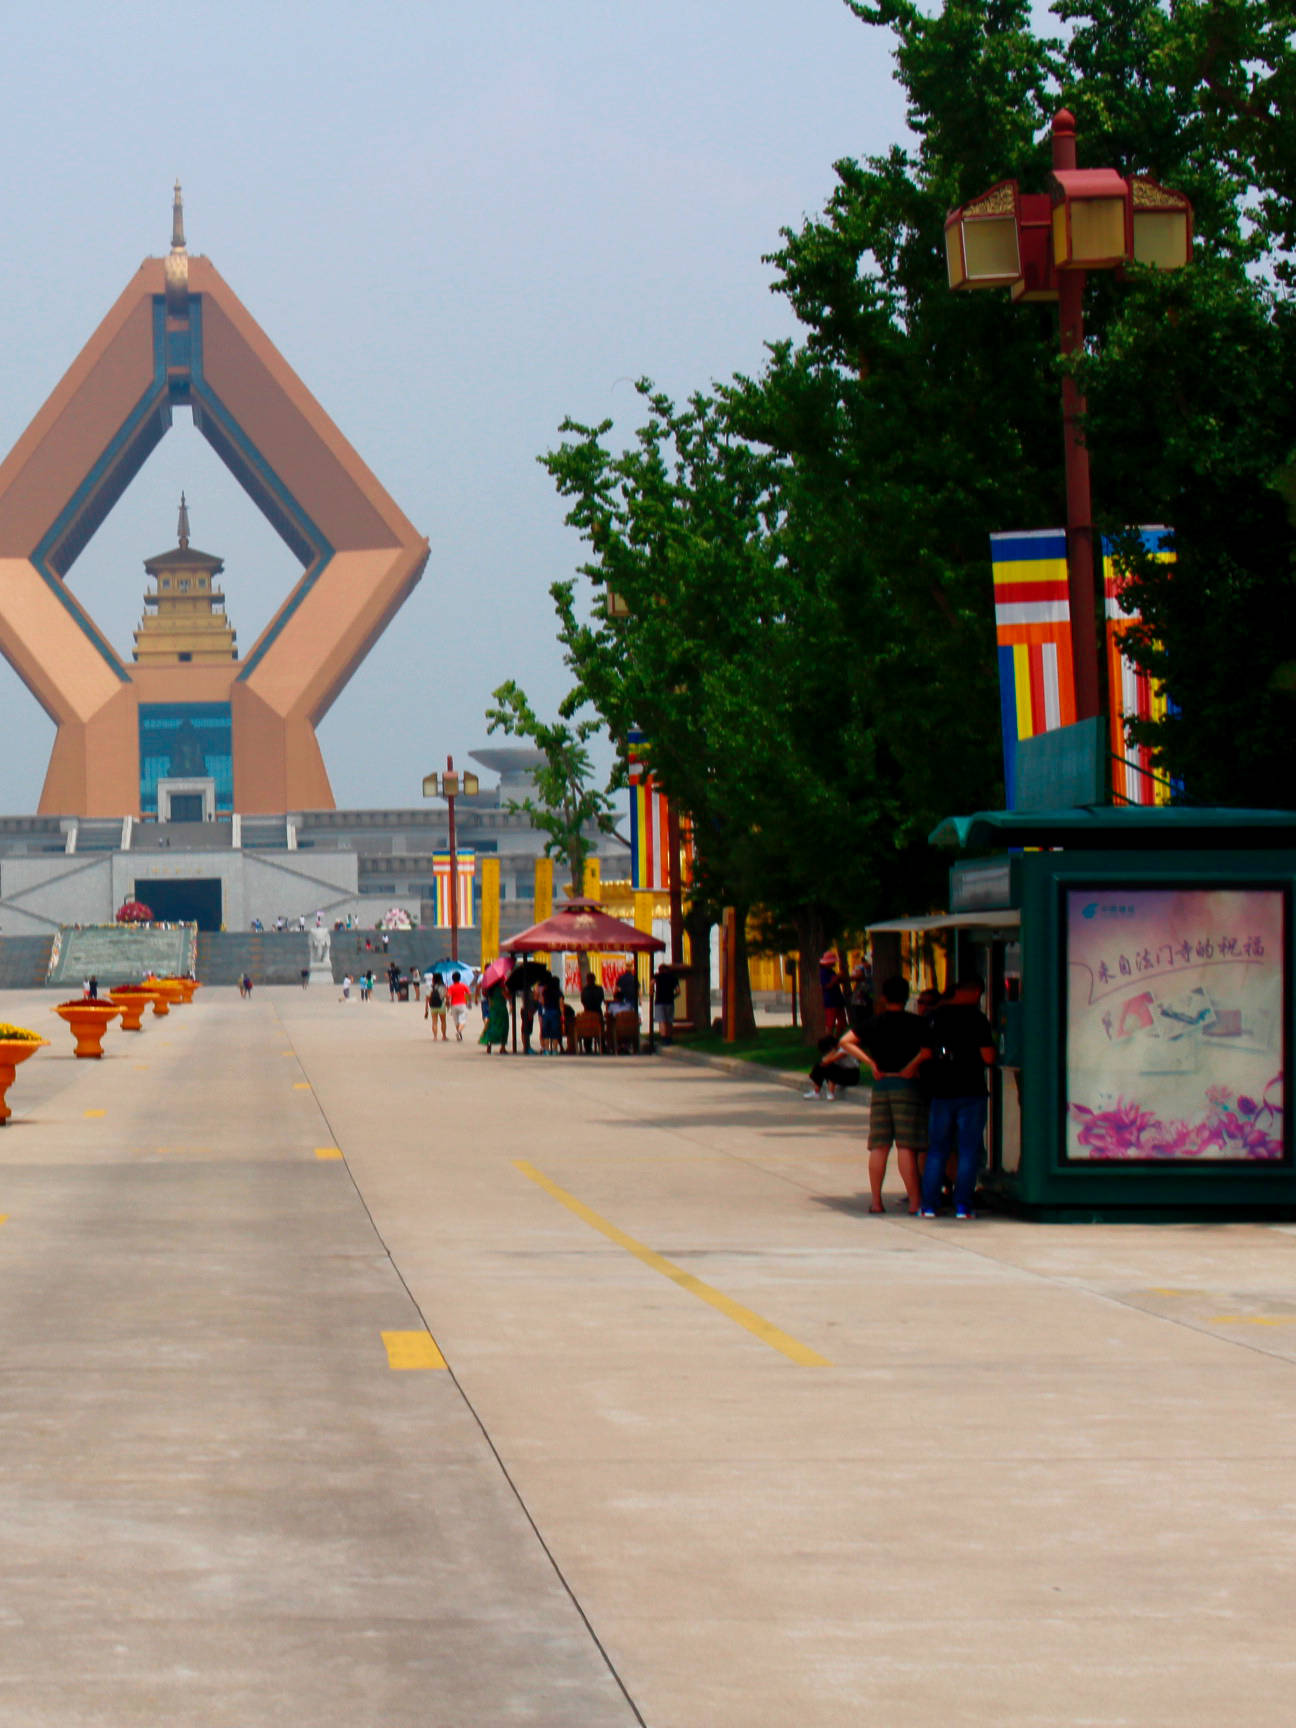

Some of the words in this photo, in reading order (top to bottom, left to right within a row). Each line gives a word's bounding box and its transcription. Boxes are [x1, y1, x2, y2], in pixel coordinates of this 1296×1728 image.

[1098, 936, 1265, 984] 来自法门寺的祝福
